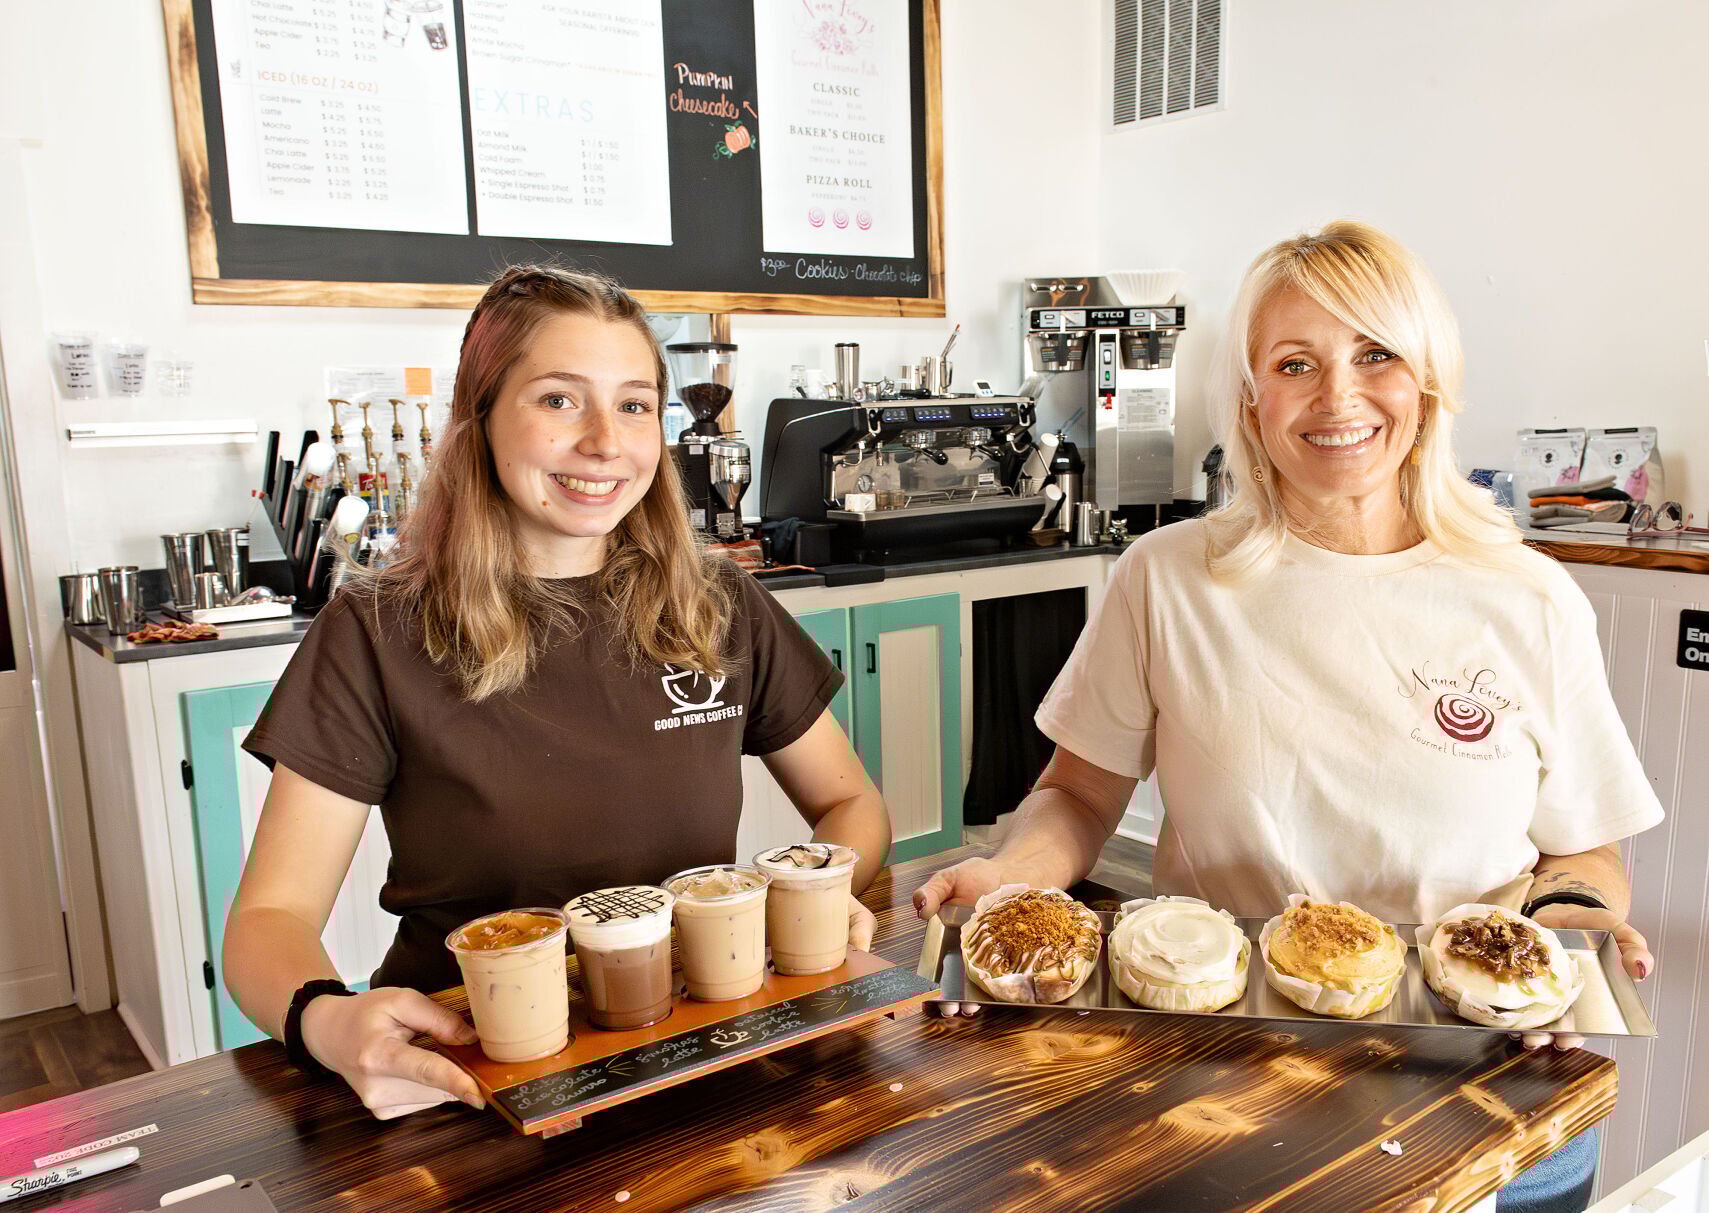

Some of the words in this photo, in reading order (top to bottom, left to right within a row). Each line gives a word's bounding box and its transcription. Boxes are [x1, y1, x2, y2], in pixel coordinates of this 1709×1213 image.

[257, 70, 287, 82] ICED
[291, 72, 308, 86] (16
[311, 76, 328, 87] OZ
[339, 79, 354, 89] 24
[357, 80, 379, 94] OZ)
[813, 81, 861, 97] CLASSIC
[474, 87, 594, 124] EXTRAS
[789, 124, 838, 140] BAKER'S
[842, 130, 886, 144] CHOICE
[806, 174, 839, 187] PIZZA
[843, 177, 872, 190] ROLL
[1091, 311, 1125, 319] FETCO
[654, 717, 681, 731] GOOD
[682, 711, 706, 727] NEWS
[706, 704, 737, 723] COFFEE
[1410, 727, 1447, 754] Gourmet
[1452, 742, 1494, 761] Cinnamon
[661, 1047, 703, 1069] latte
[7, 1171, 64, 1198] Sharpie
